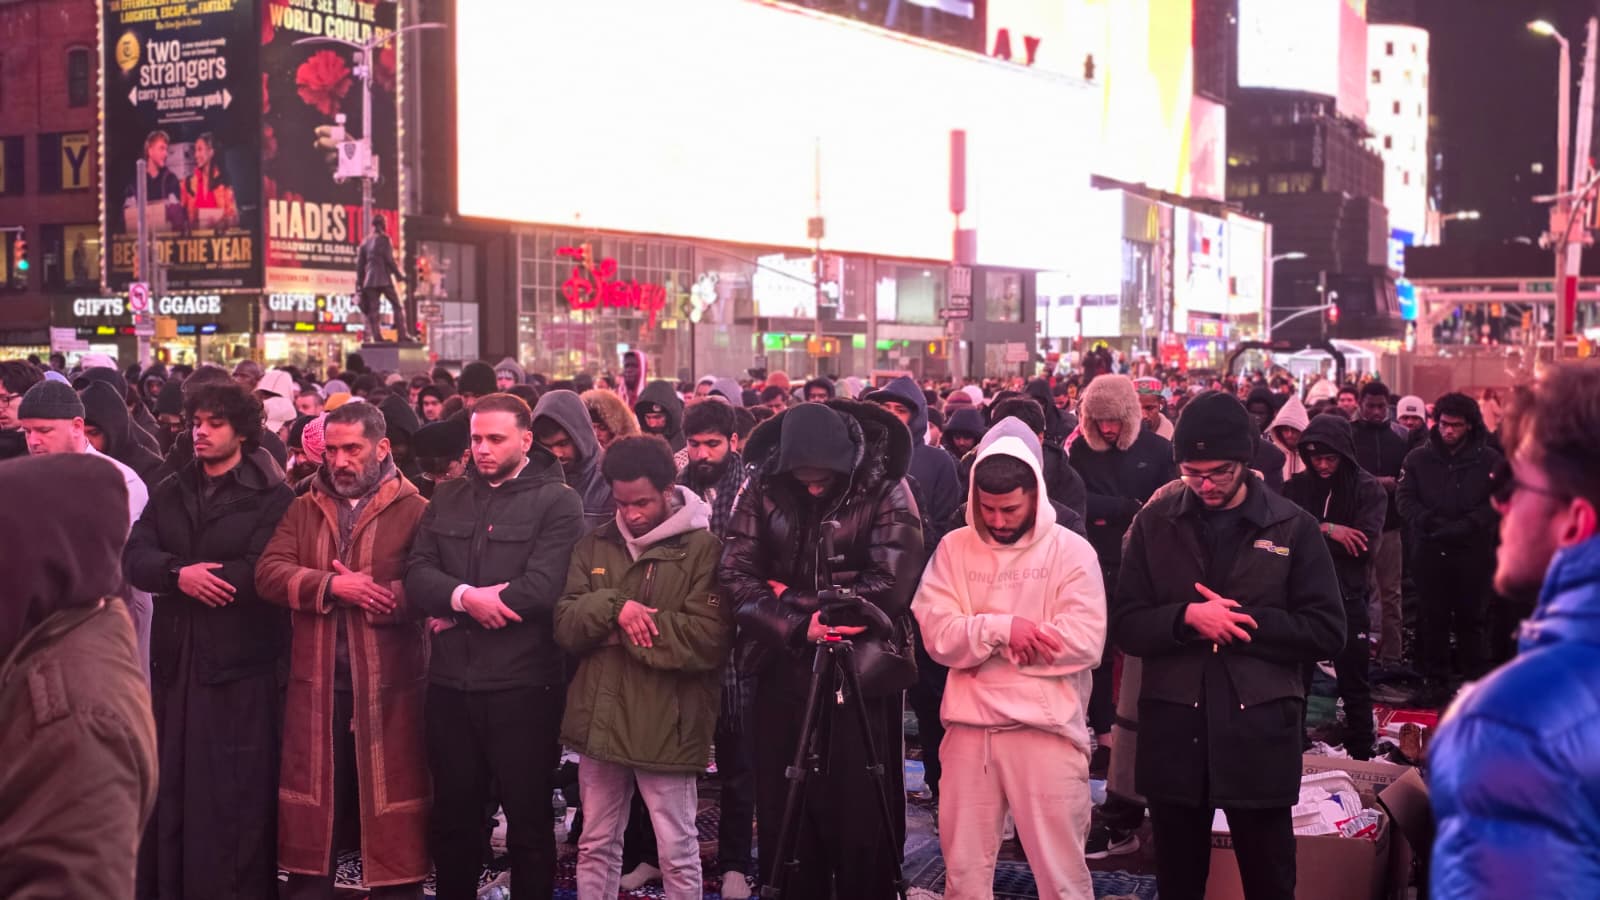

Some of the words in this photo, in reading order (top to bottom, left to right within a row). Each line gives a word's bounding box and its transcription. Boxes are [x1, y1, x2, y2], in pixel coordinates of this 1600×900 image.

[358, 2, 376, 21] THE
[269, 3, 322, 35] WORLD
[325, 15, 371, 45] COULD
[146, 38, 180, 63] two
[140, 56, 227, 88] strangers
[138, 88, 158, 102] carry
[157, 97, 184, 110] across
[185, 96, 203, 107] new
[64, 146, 88, 186] Y
[268, 199, 399, 249] HADESTN
[156, 240, 174, 263] OF
[176, 239, 208, 262] THE
[211, 237, 252, 262] YEAR
[324, 244, 355, 255] GLOBAL
[557, 247, 667, 330] Disney
[73, 298, 124, 316] GIFTS
[147, 296, 222, 315] GGAGE
[269, 294, 316, 311] GIFTS
[1022, 567, 1049, 580] GOD
